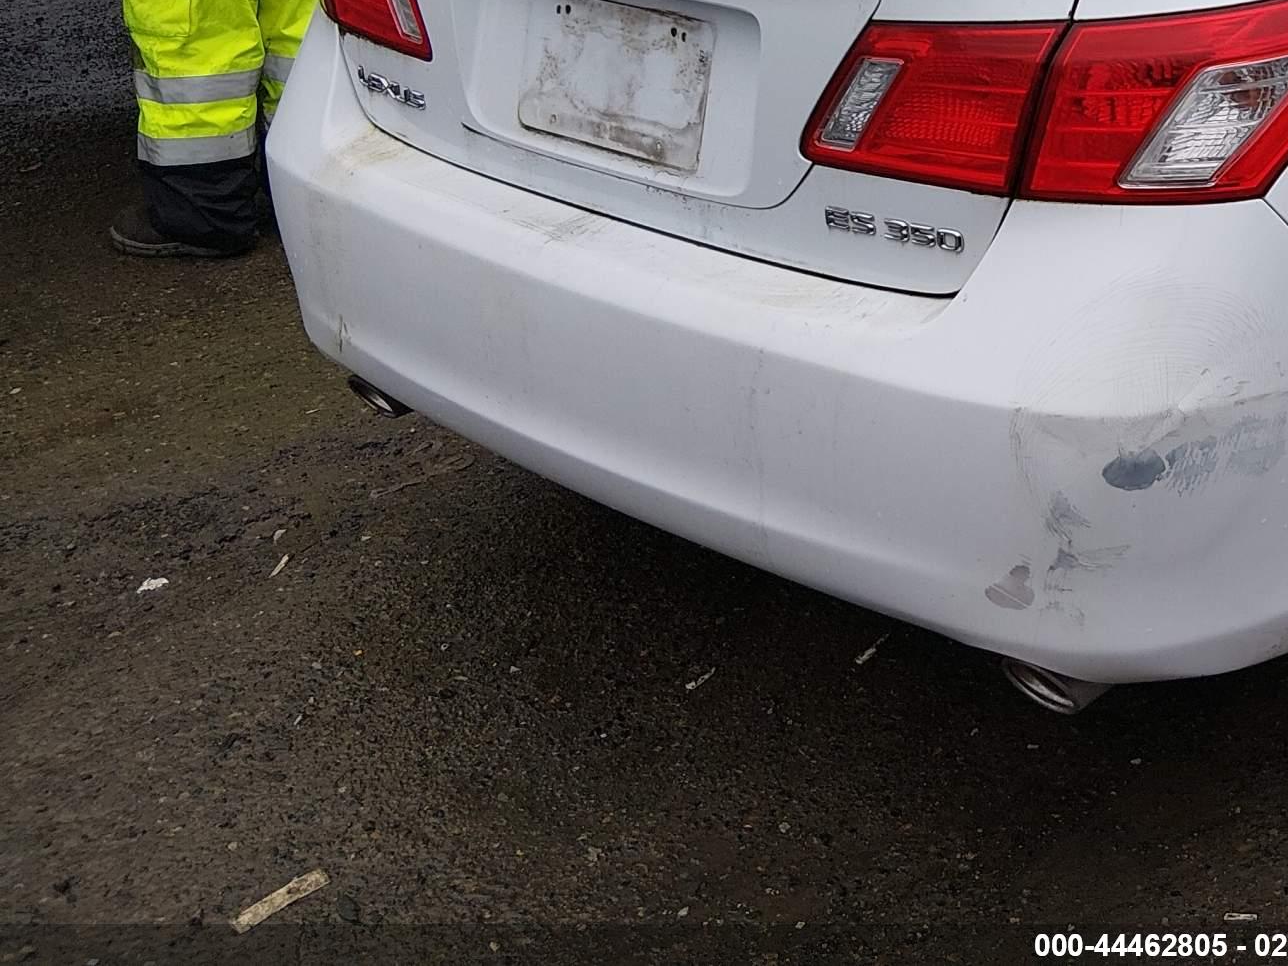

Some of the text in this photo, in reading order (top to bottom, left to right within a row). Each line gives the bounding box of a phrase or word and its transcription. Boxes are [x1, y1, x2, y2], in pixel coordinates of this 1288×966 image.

[357, 65, 427, 110] LEXUS
[825, 205, 965, 253] ES 350
